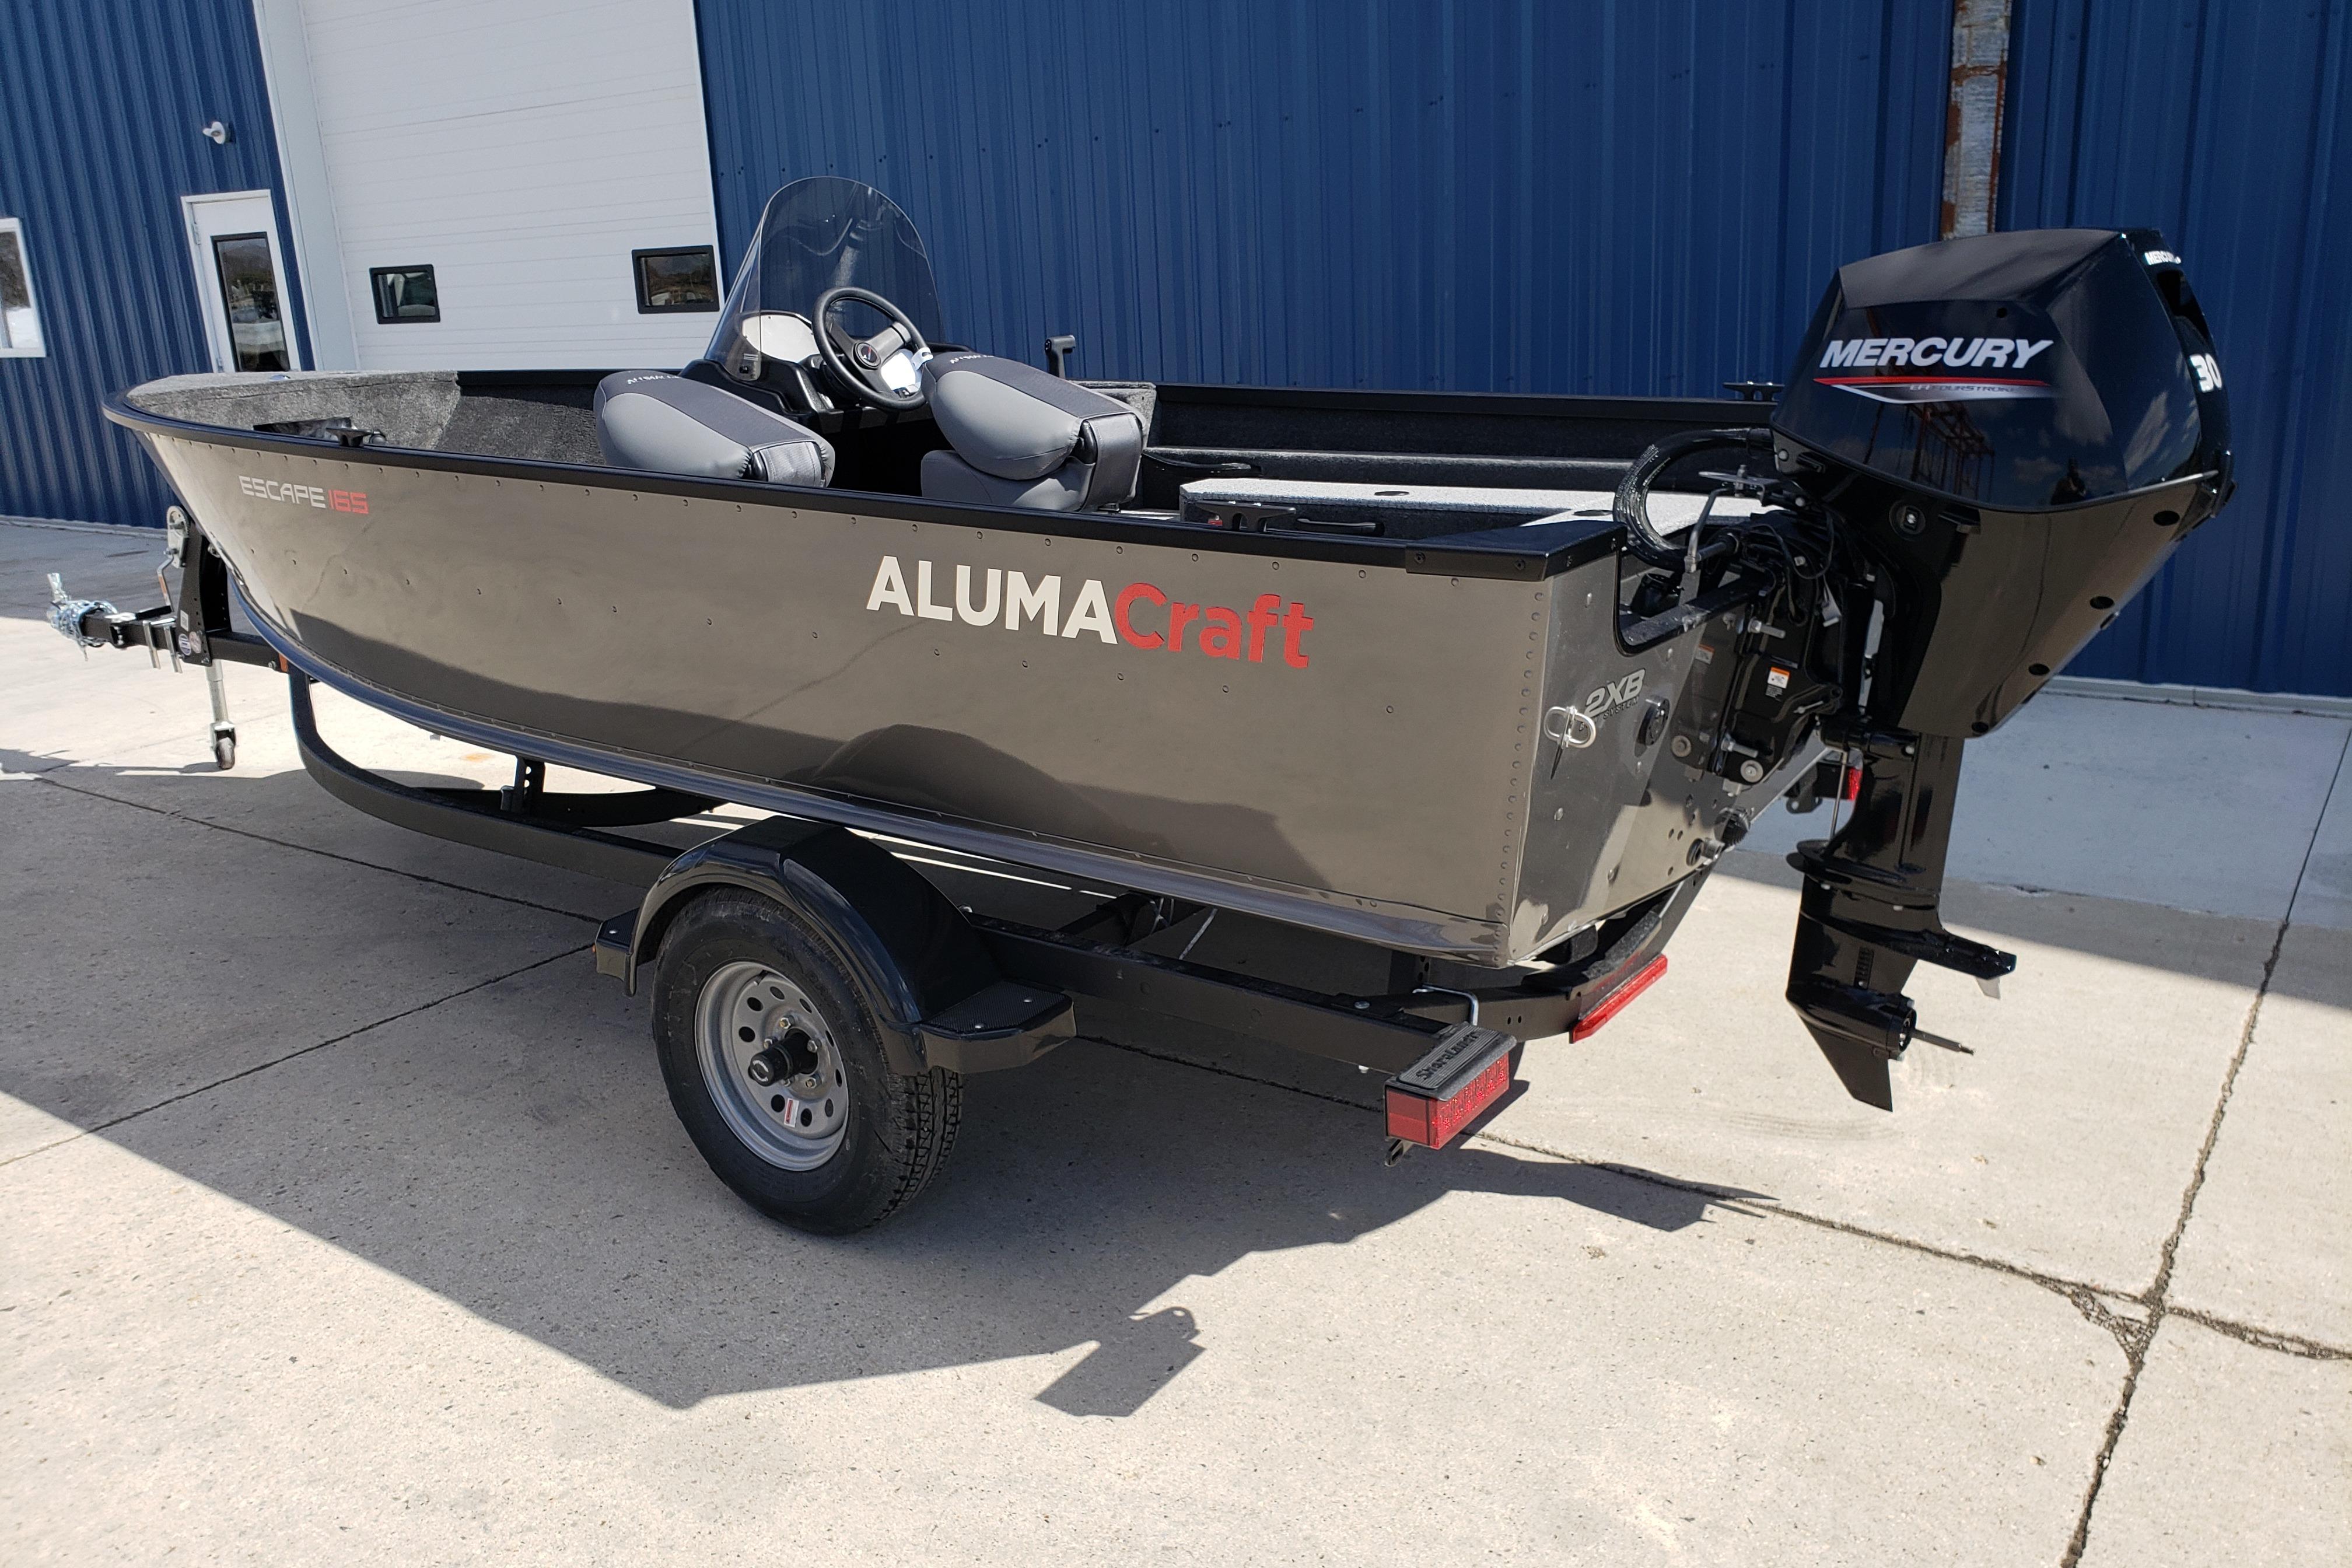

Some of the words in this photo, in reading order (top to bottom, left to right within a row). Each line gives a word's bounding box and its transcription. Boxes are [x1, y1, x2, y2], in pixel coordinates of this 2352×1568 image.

[1819, 337, 2054, 369] MERCURY
[2189, 352, 2222, 393] 30
[238, 475, 326, 509] ESCAPE
[328, 489, 369, 514] 165
[866, 555, 1314, 669] ALUMACraft
